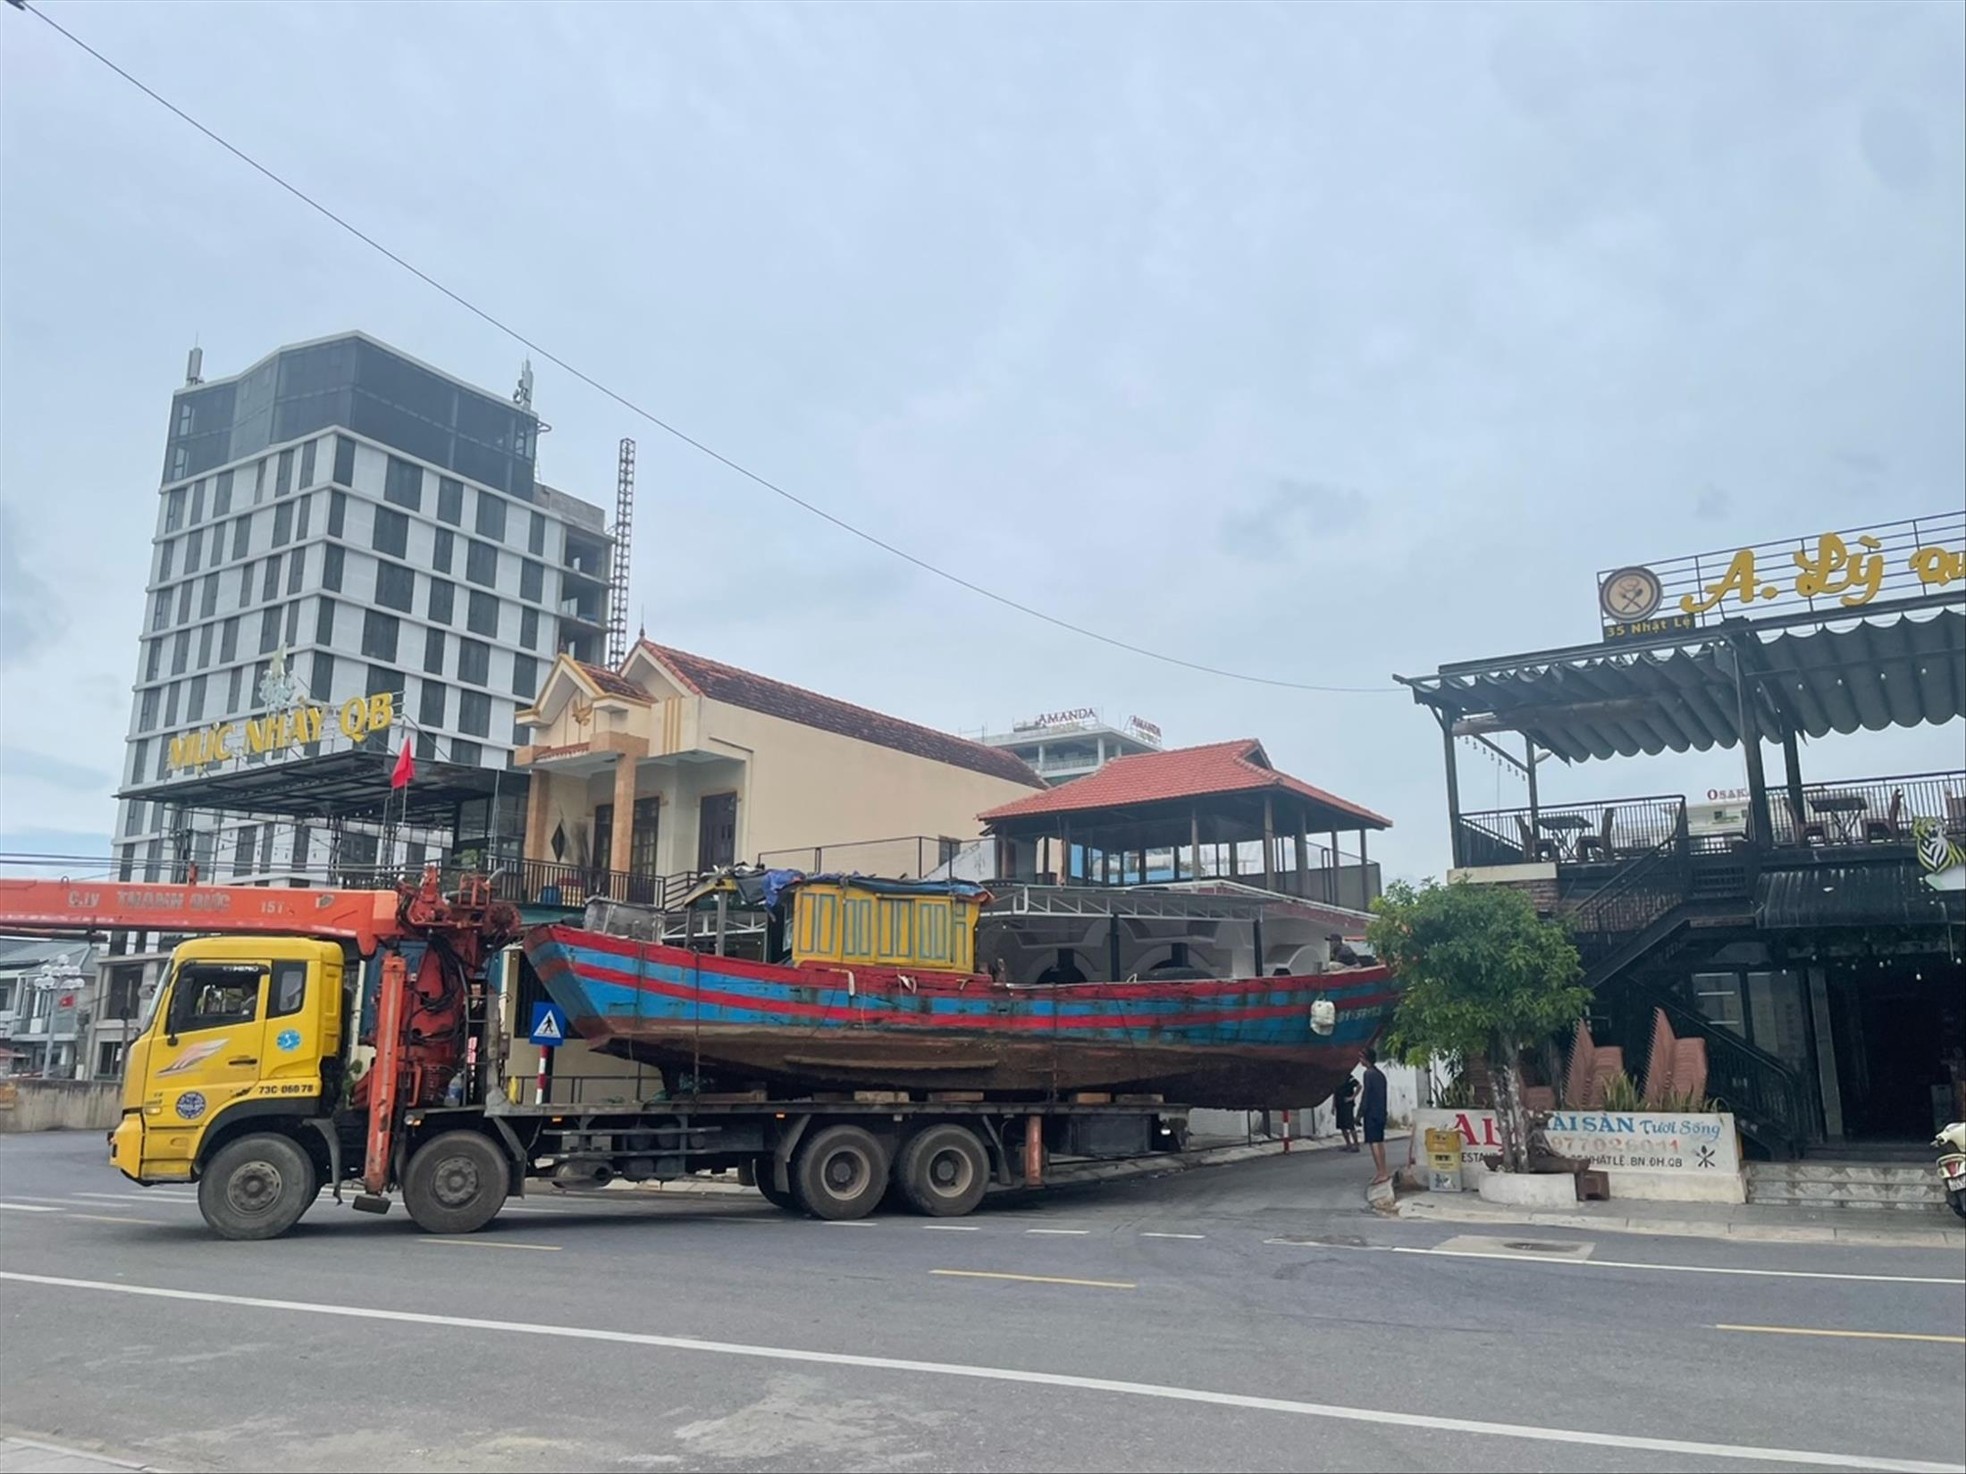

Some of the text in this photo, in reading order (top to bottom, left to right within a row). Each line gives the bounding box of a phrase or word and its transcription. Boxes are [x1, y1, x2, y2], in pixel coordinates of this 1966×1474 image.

[1793, 532, 1883, 606] Lỳ
[1607, 616, 1690, 637] 35 Nhật Lệ
[341, 692, 394, 743] QB
[1037, 708, 1096, 724] AMANDA
[1707, 789, 1749, 800] OSAK
